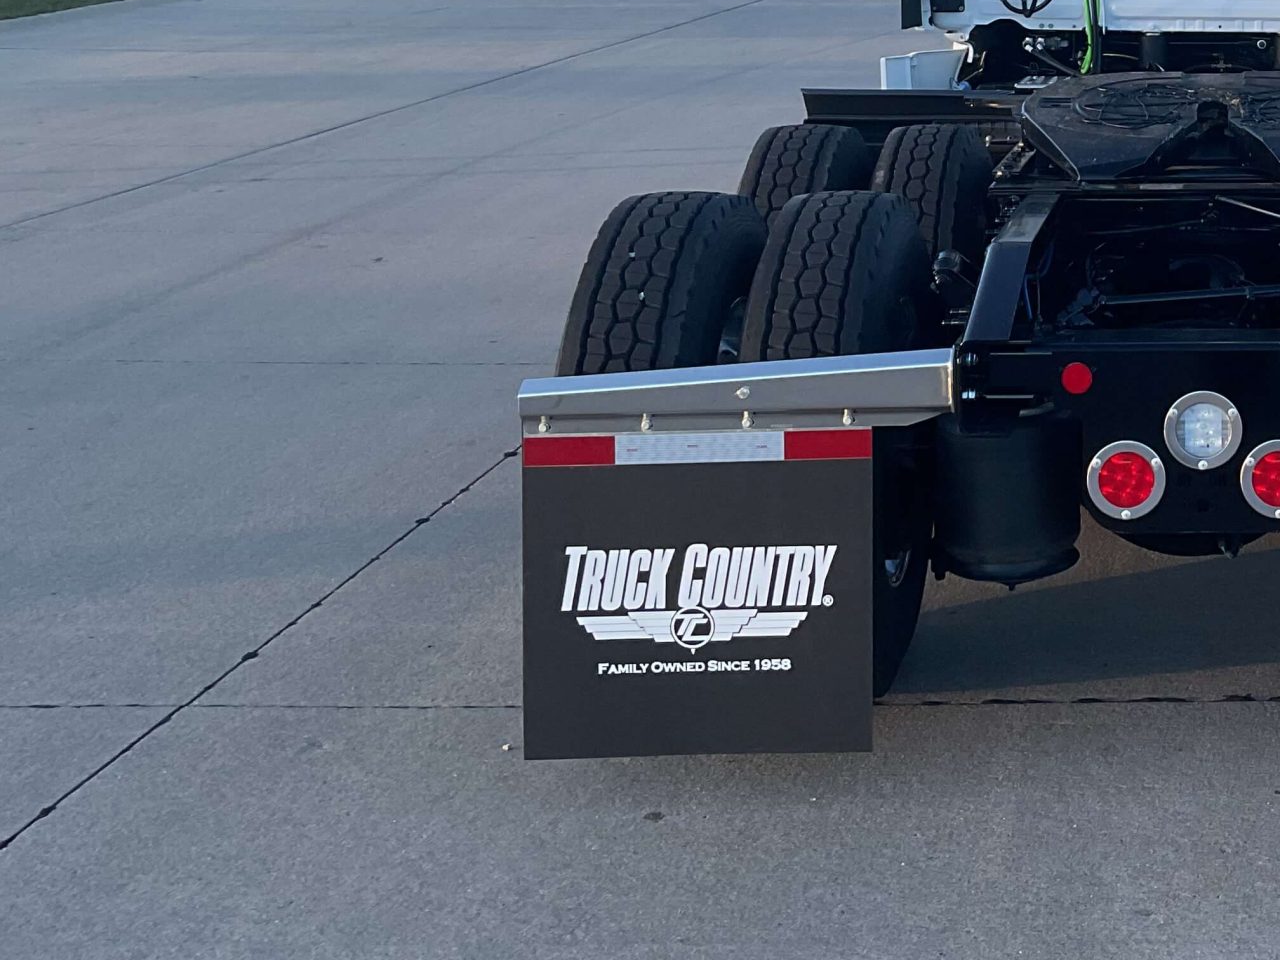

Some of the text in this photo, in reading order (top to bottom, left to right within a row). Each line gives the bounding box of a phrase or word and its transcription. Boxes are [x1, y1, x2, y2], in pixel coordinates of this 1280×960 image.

[561, 543, 837, 611] TRUCK COUNTRY
[598, 658, 792, 675] FAMILY OWNED SINCE 1958
